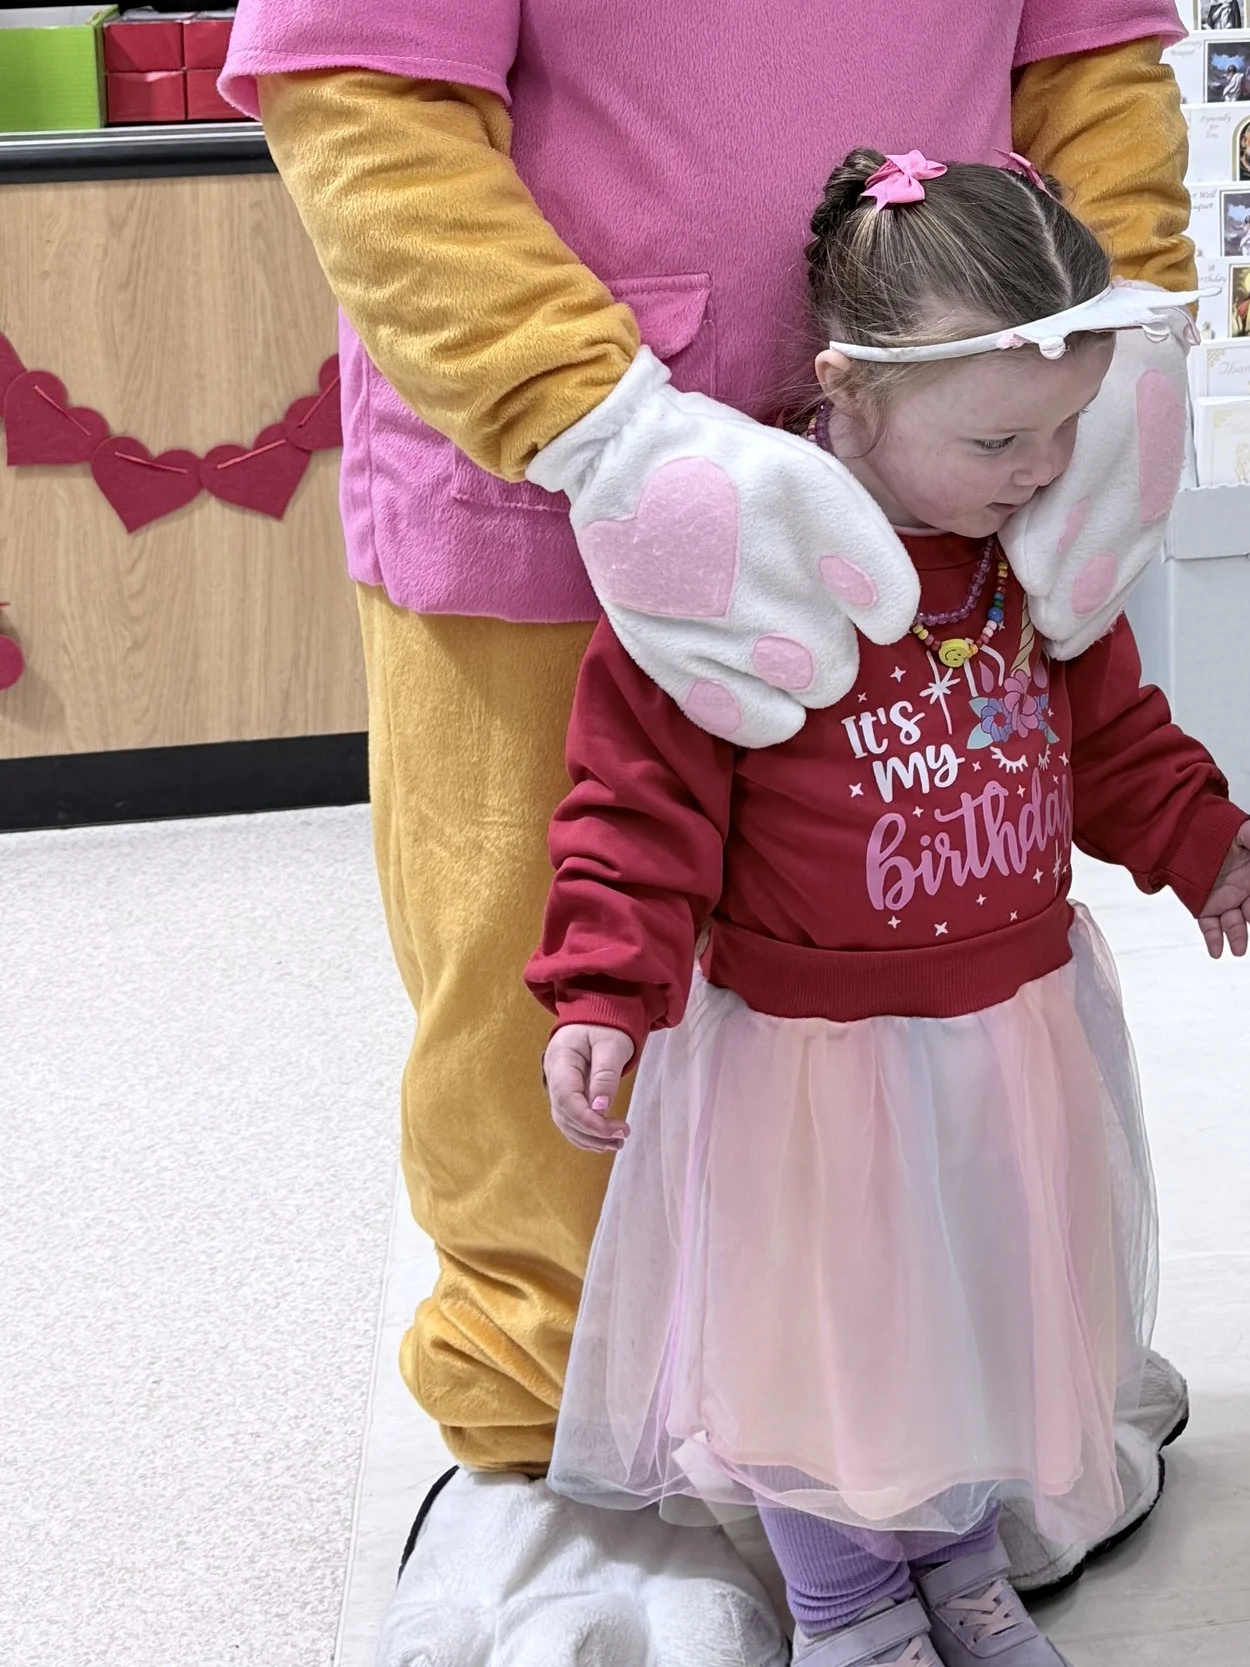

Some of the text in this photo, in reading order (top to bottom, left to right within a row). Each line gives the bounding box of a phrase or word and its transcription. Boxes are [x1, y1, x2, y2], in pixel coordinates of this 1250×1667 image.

[840, 700, 926, 759] It's
[872, 743, 966, 803] my
[865, 767, 1074, 911] birthday
